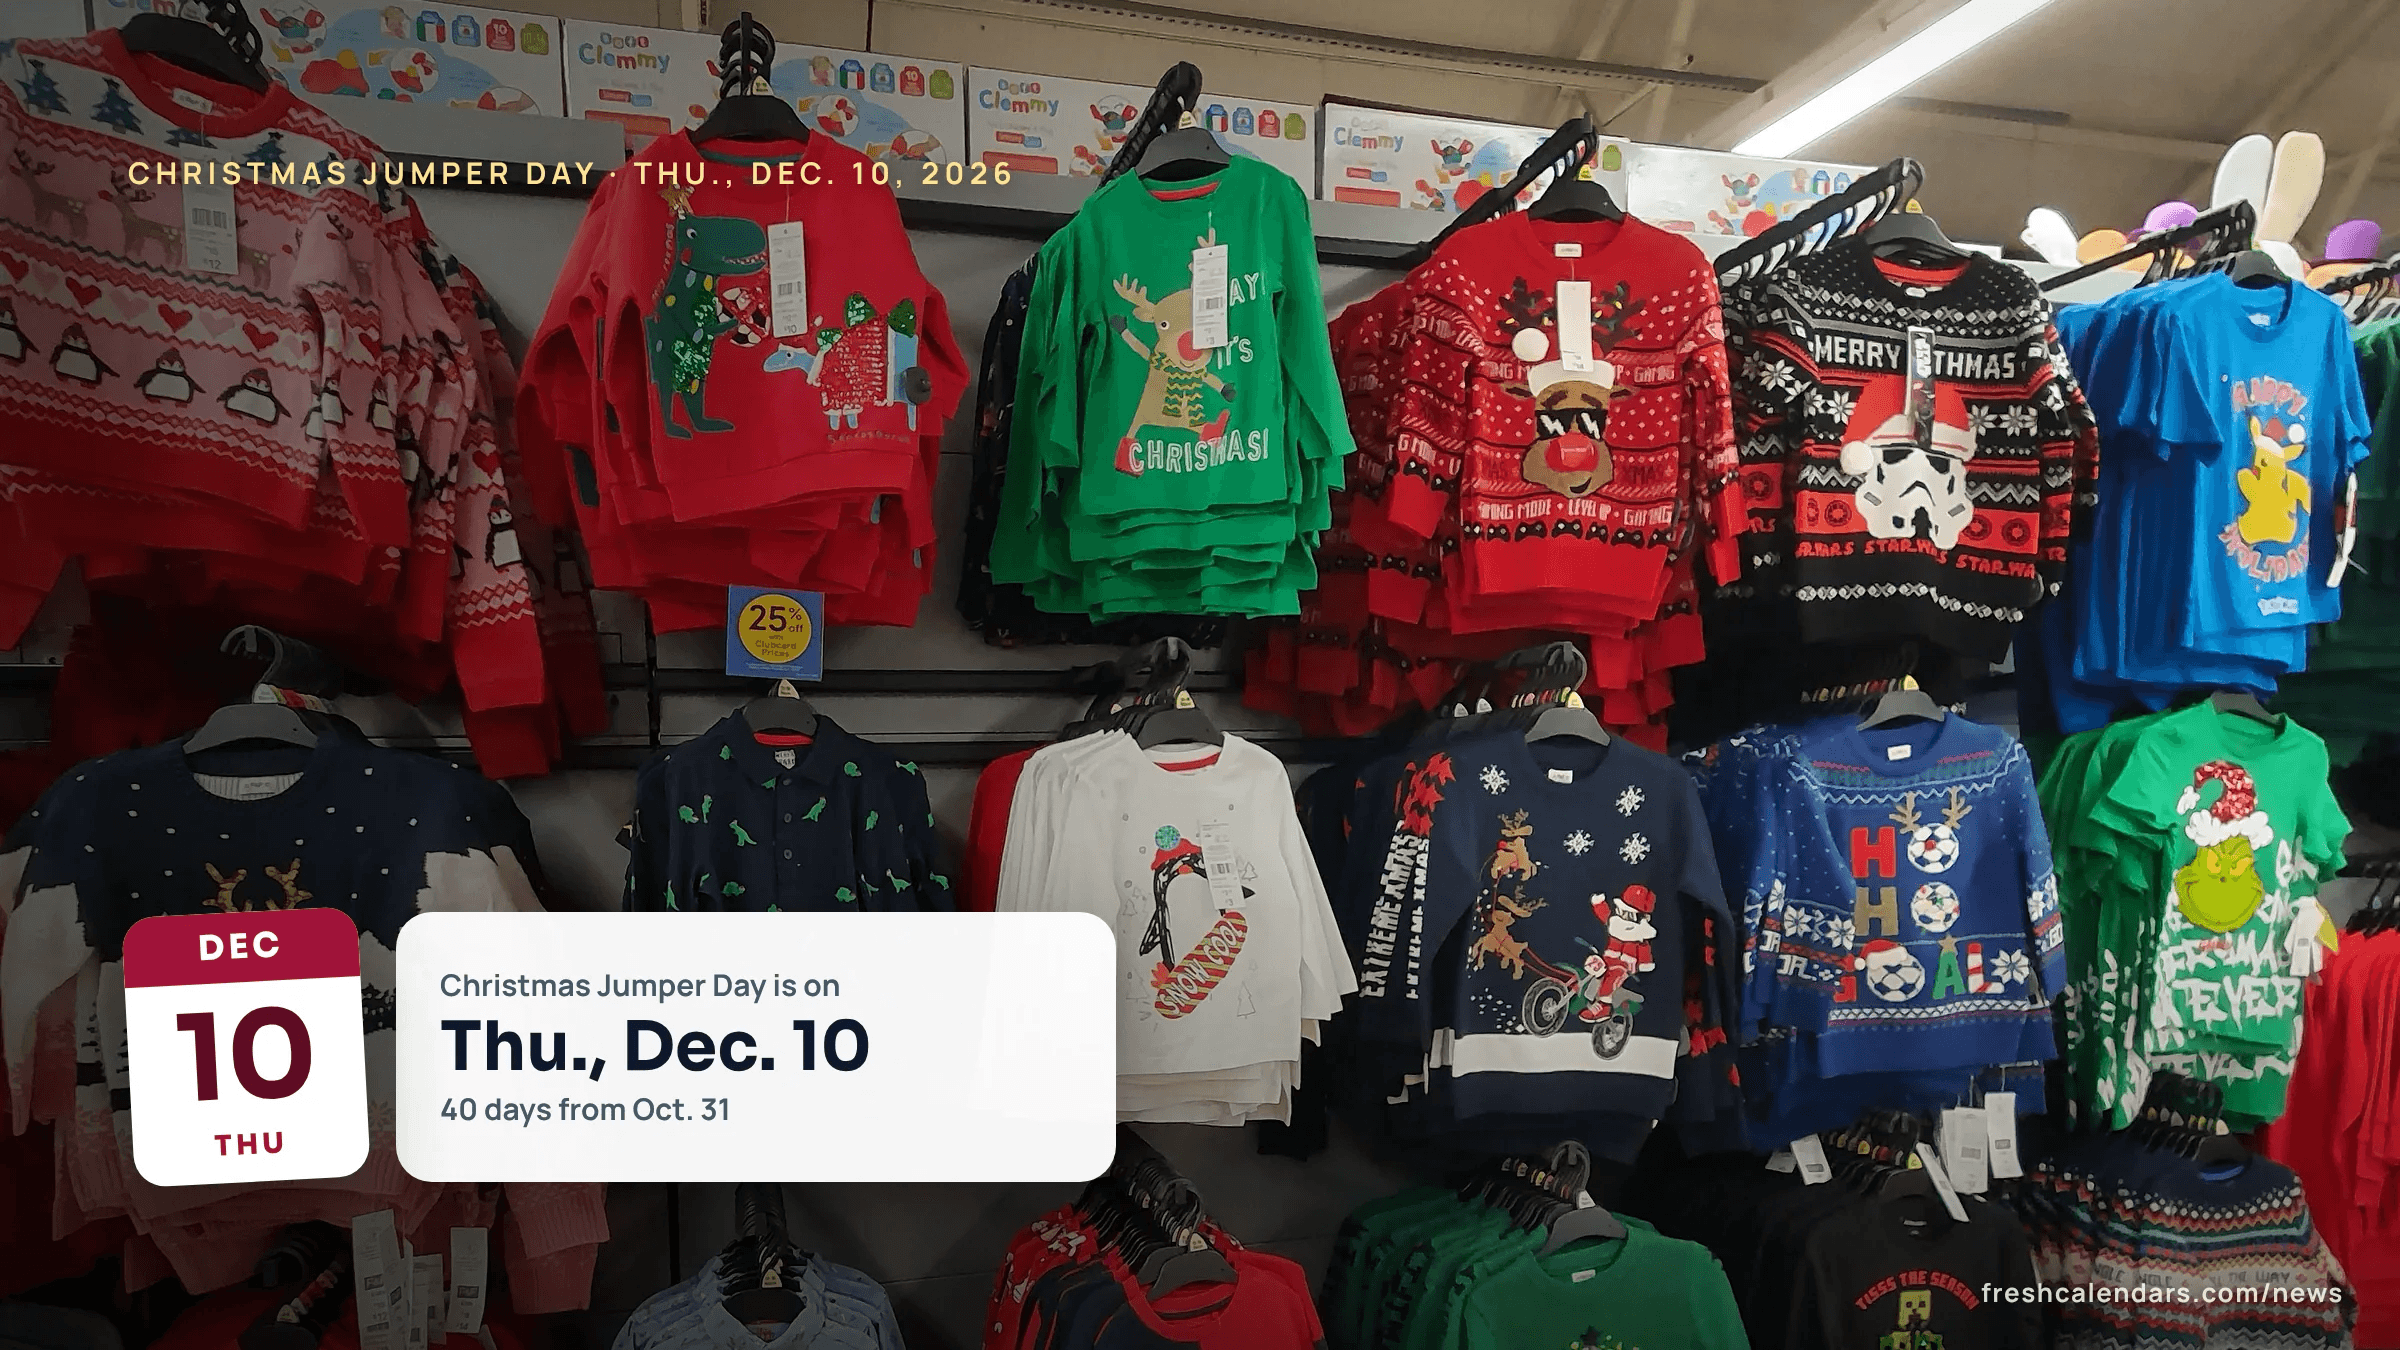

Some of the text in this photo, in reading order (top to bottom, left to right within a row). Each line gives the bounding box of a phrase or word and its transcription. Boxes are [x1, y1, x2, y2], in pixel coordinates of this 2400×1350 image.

[1814, 334, 1901, 369] MERRY
[1933, 349, 2016, 380] THMAS
[1864, 538, 1915, 557] STAR
[1955, 554, 2006, 576] STAR
[748, 604, 804, 633] 25% off
[755, 640, 797, 649] Clubcard
[761, 649, 790, 657] Prices
[1158, 920, 1243, 1017] SNOW COOL
[1899, 1270, 1928, 1287] THE
[1930, 1271, 1980, 1311] SEASON
